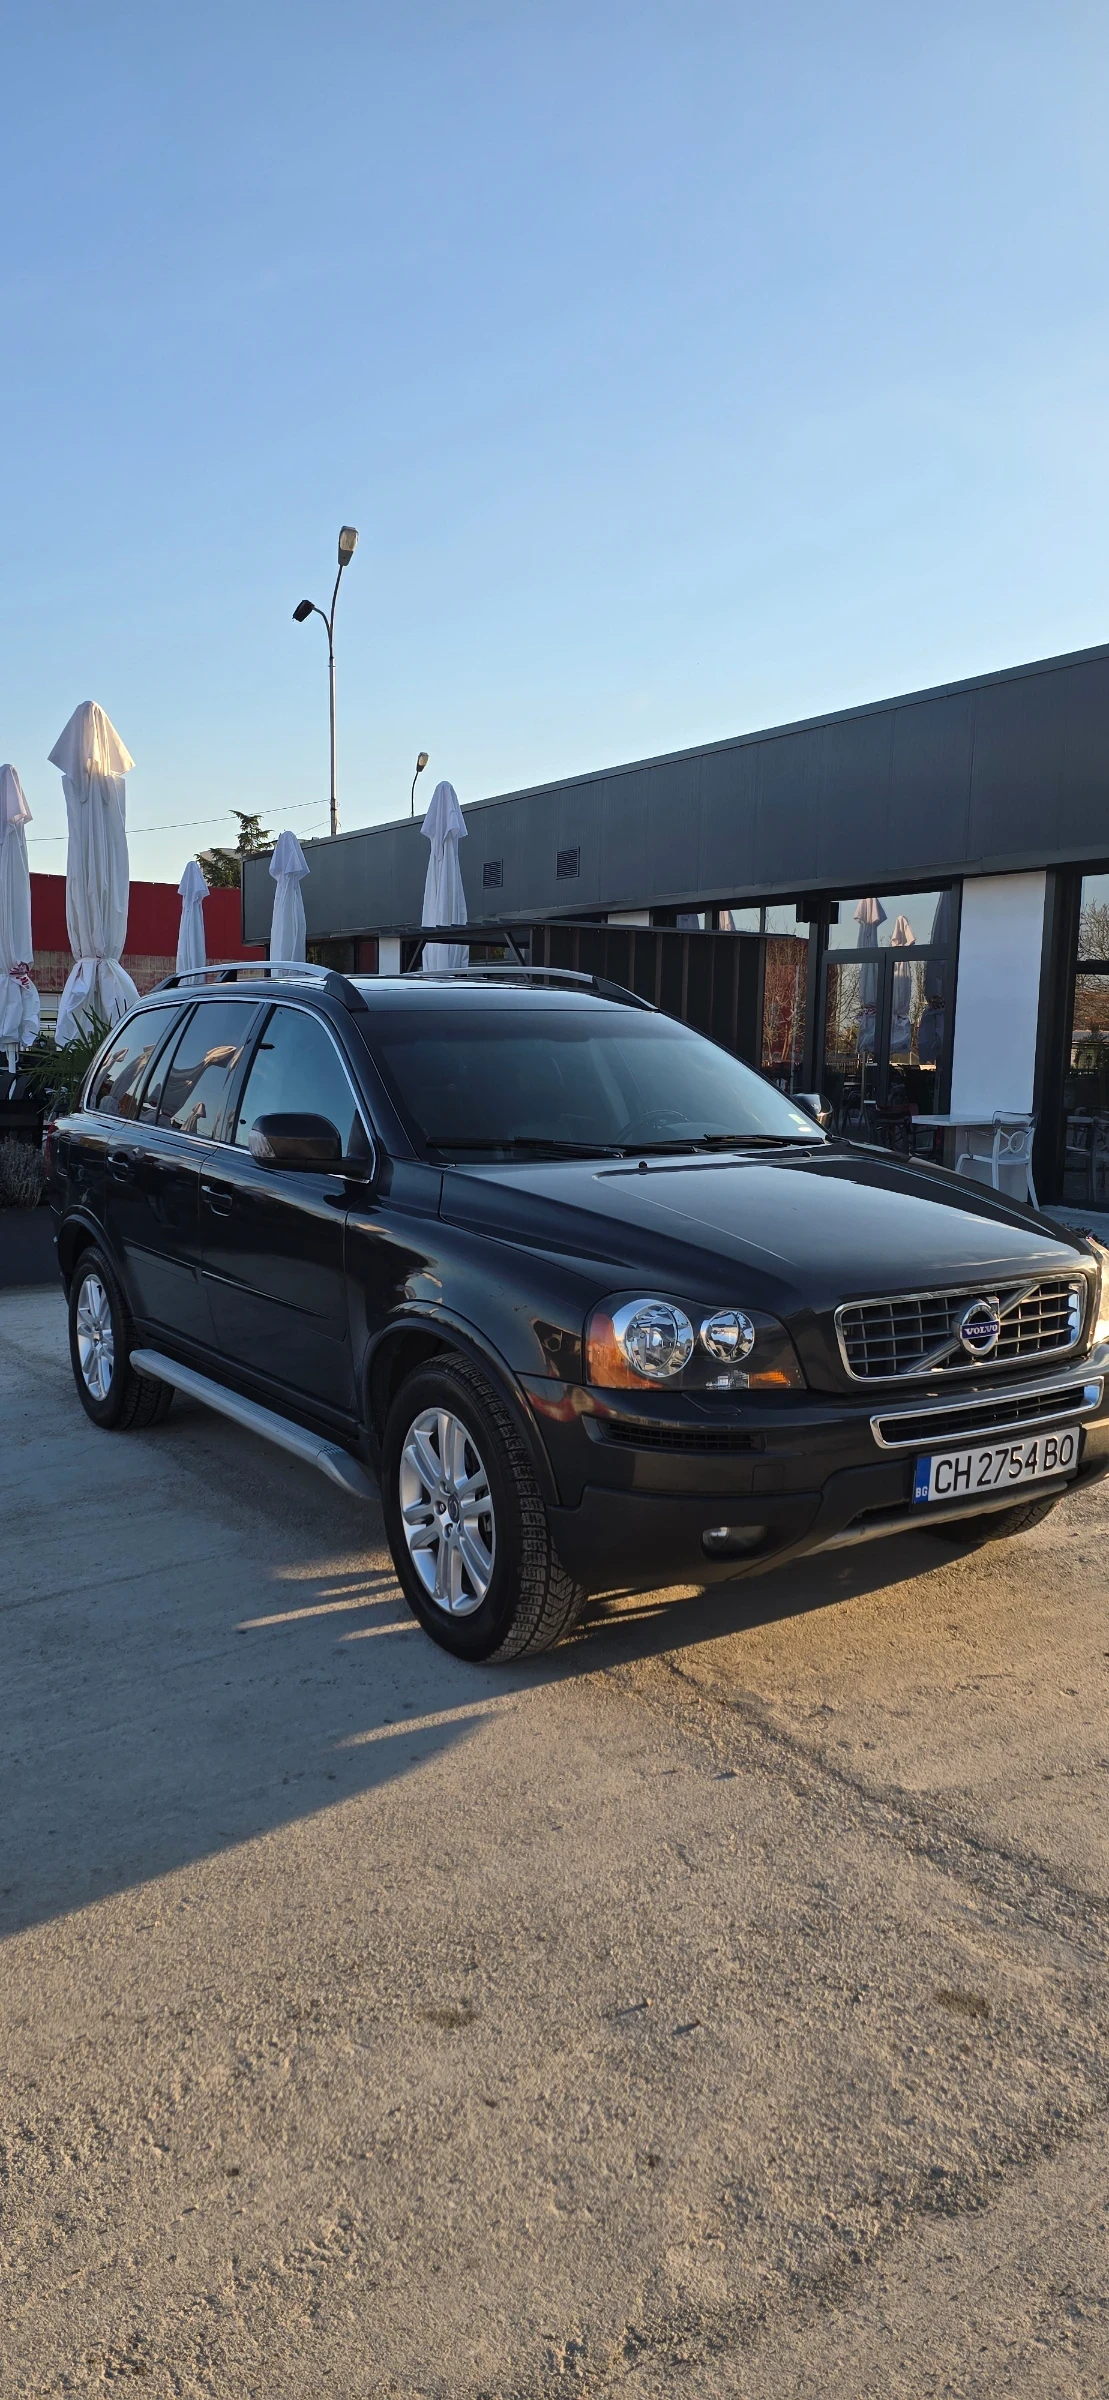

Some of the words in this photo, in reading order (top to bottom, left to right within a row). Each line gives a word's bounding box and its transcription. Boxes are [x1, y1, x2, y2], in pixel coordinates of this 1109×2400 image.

[964, 1324, 998, 1335] VOLVO
[934, 1456, 972, 1494] CH
[976, 1441, 1038, 1487] 2754
[1043, 1434, 1074, 1472] BO
[915, 1486, 928, 1498] BG
